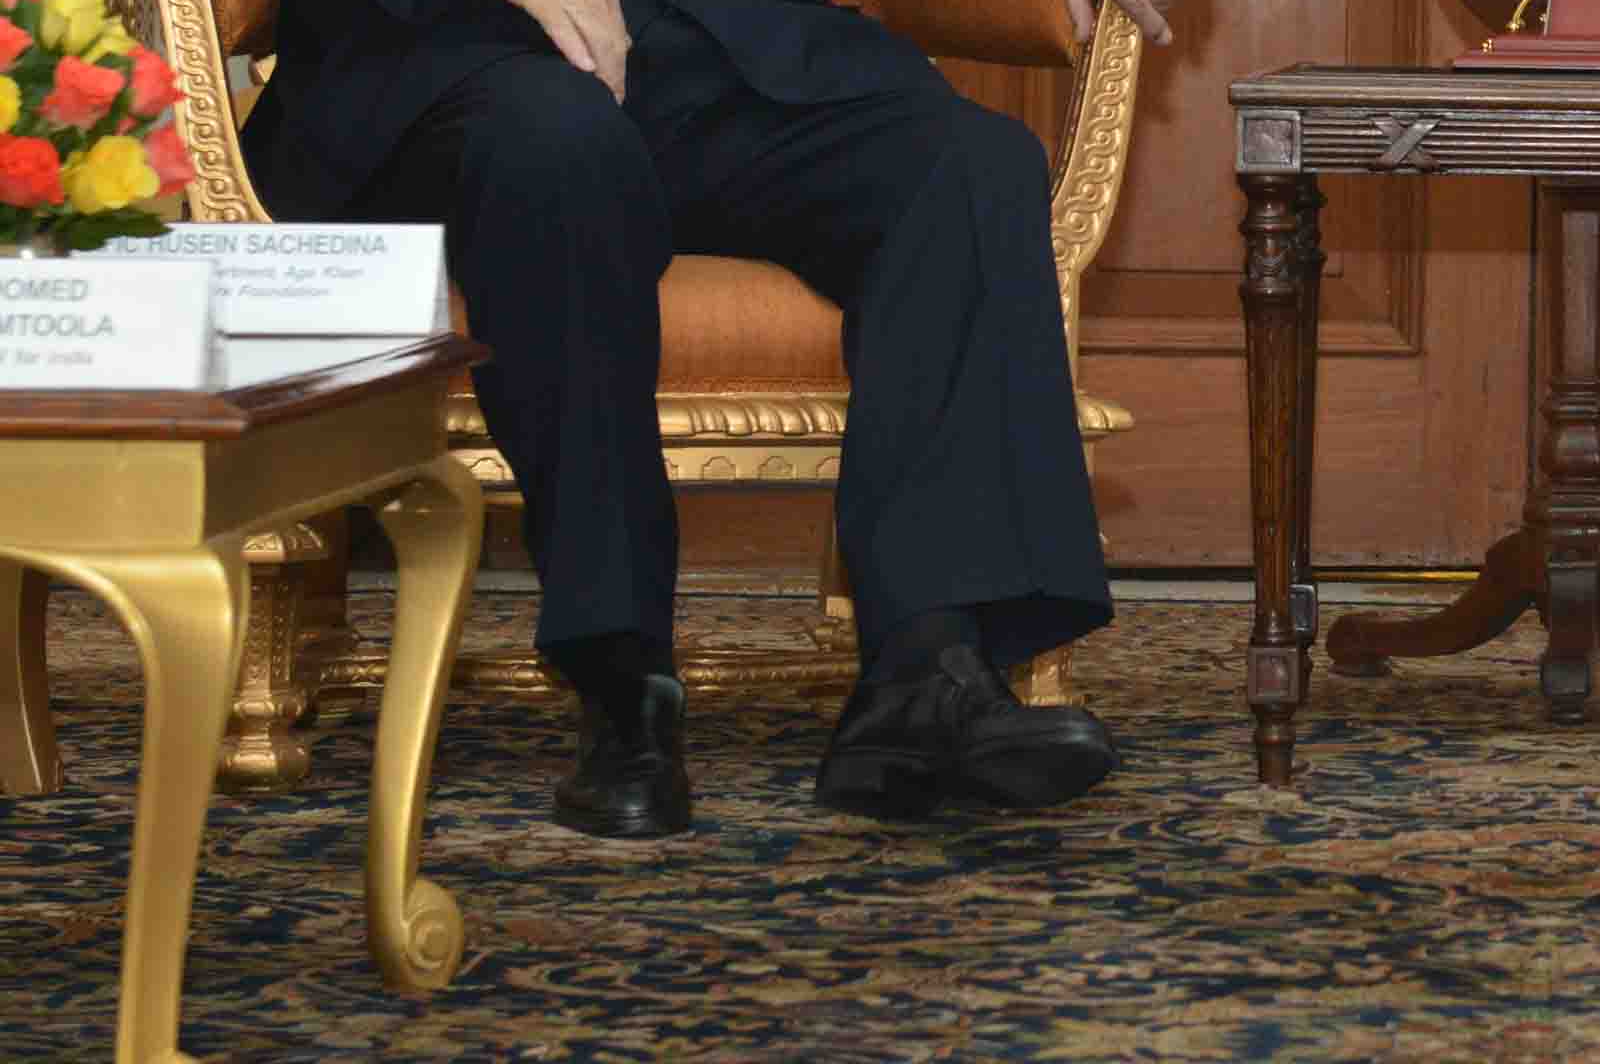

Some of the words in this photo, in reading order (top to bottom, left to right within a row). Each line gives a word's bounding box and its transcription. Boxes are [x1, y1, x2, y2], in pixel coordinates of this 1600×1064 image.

[149, 233, 239, 256] HUSEIN
[246, 232, 387, 255] SACHEDINA
[0, 278, 89, 302] OMED
